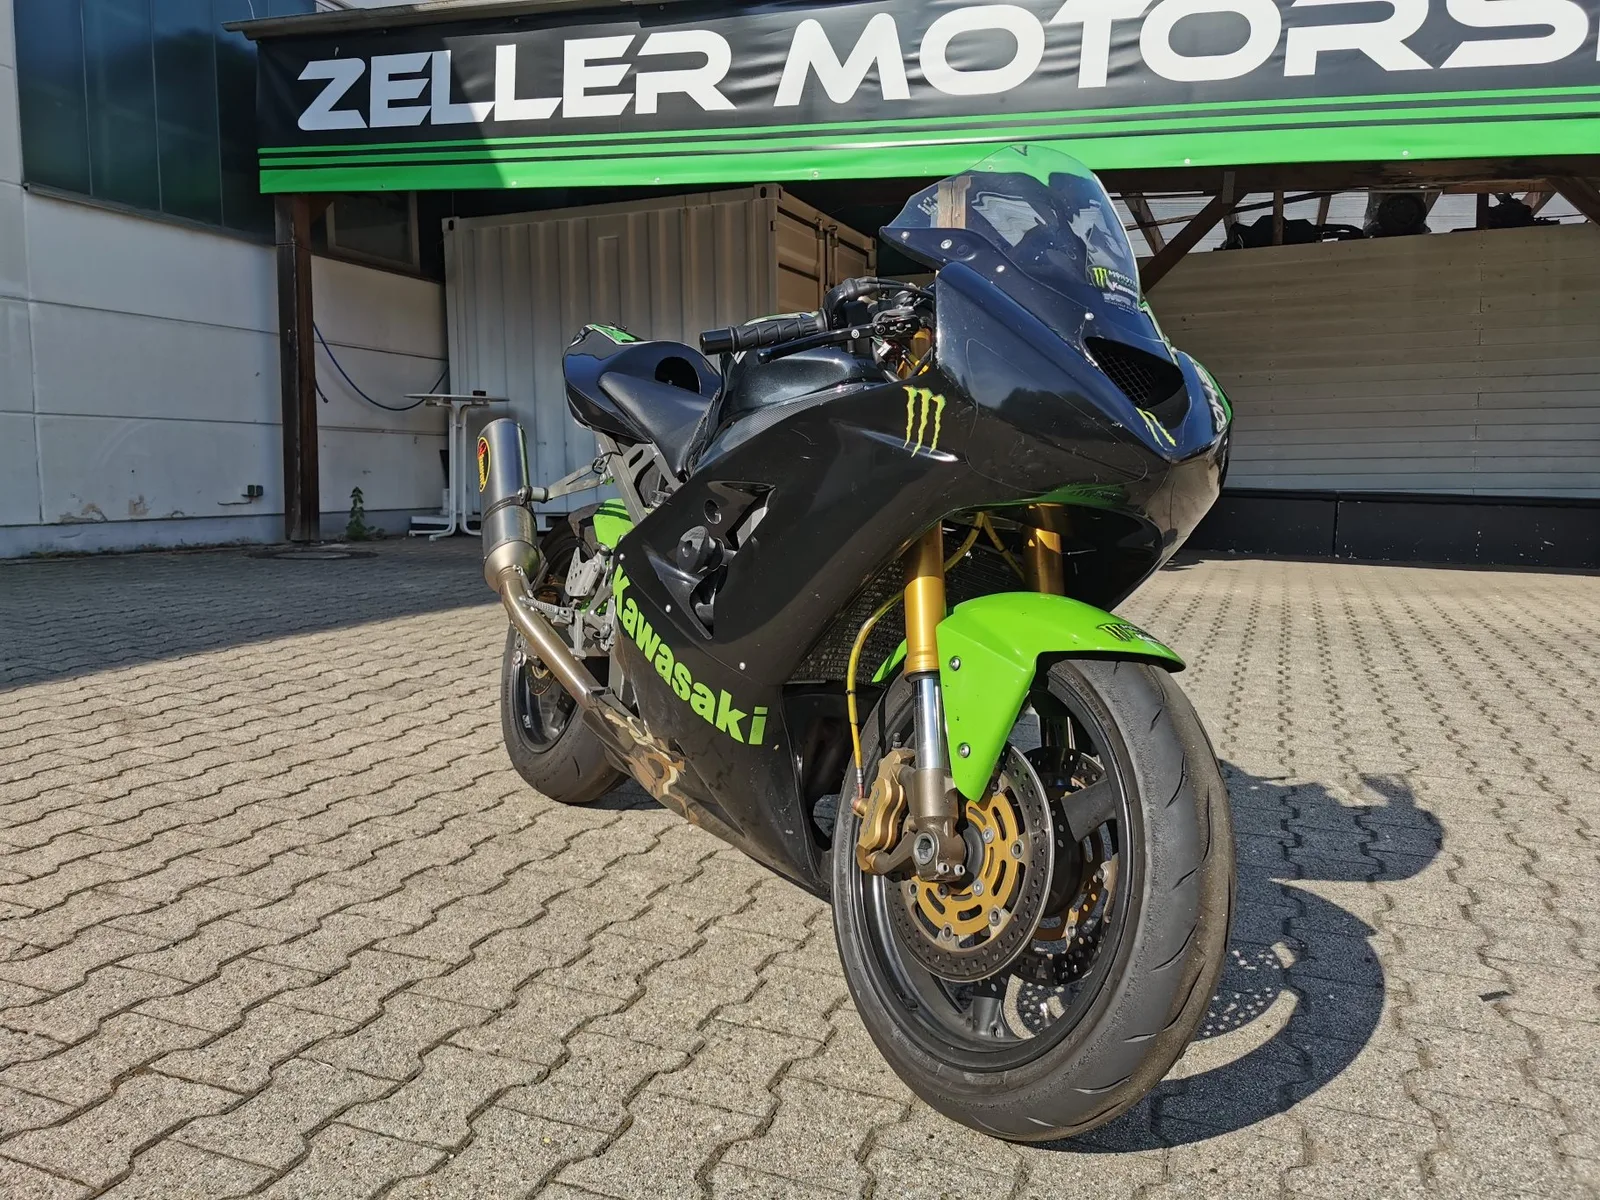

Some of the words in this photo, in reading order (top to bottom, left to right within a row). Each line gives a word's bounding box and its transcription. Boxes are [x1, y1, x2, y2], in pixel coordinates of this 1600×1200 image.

[297, 29, 736, 130] ZELLER
[774, 0, 1600, 107] MOTORS
[612, 564, 768, 745] Kawasaki
